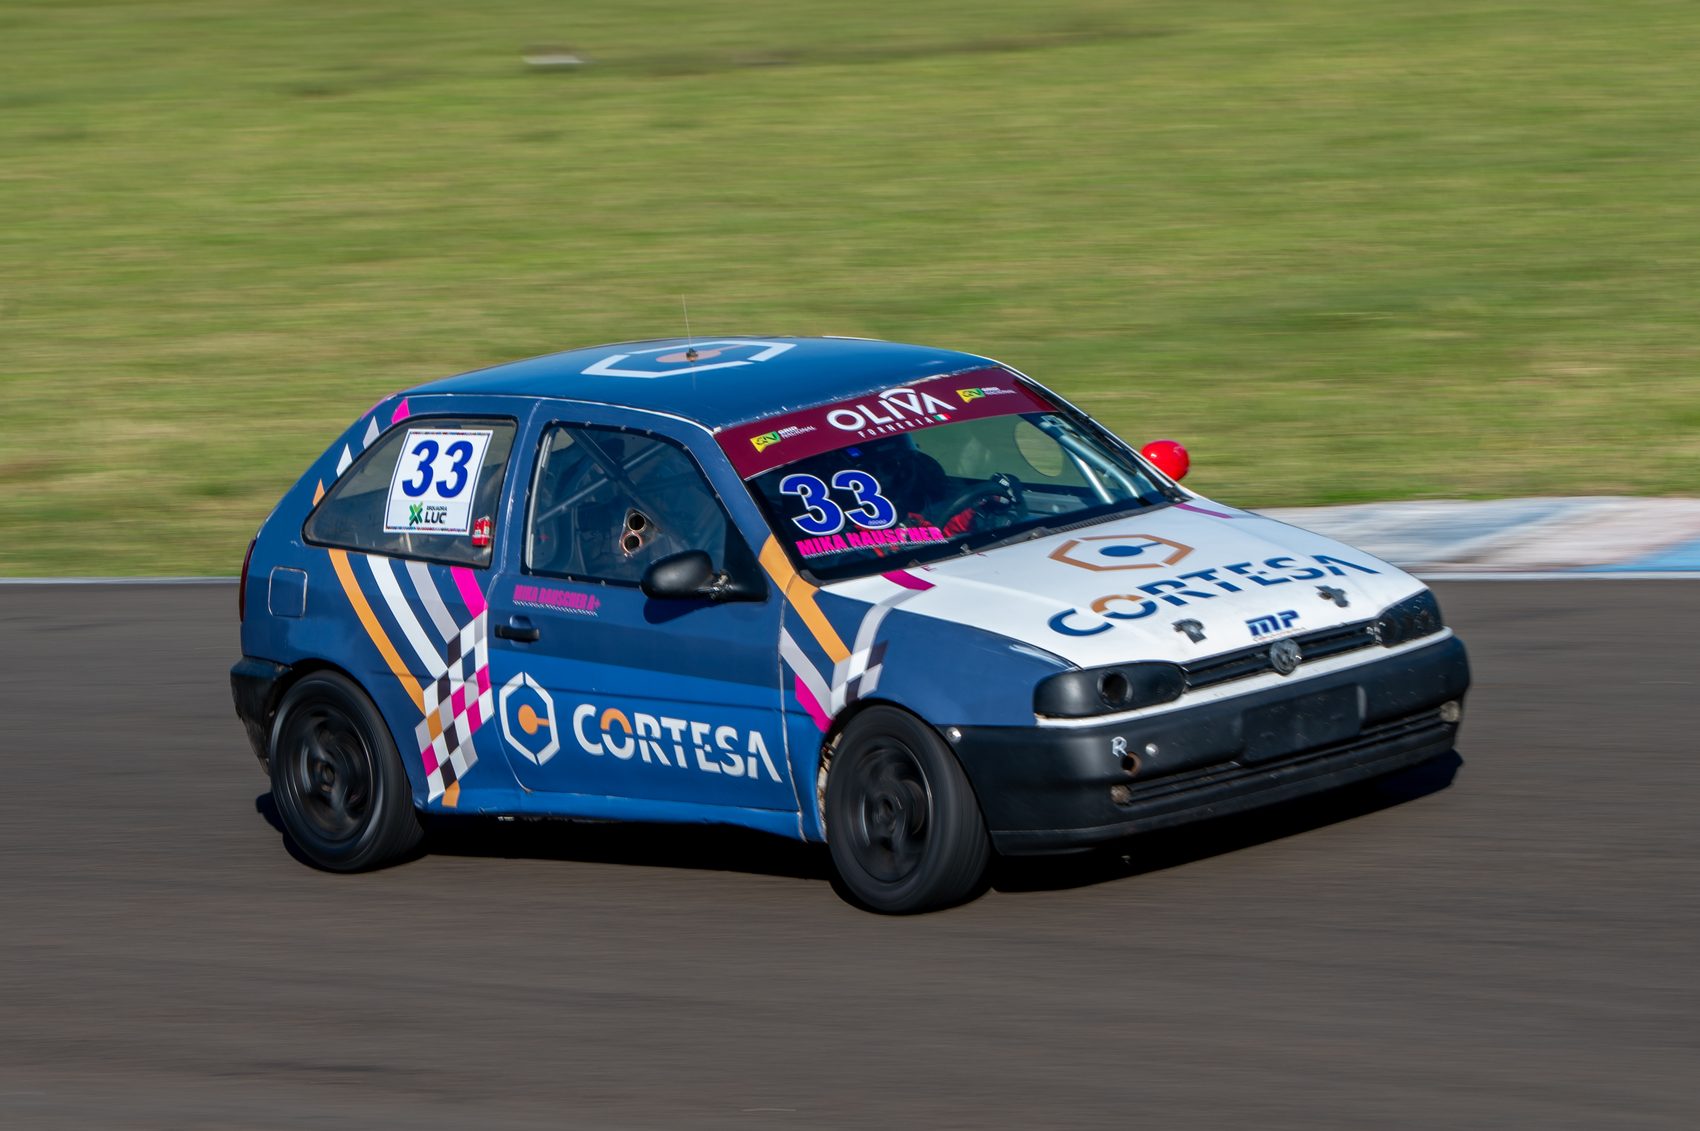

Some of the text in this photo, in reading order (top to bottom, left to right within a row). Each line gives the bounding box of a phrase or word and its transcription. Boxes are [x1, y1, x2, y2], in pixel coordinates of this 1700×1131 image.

[826, 388, 957, 431] OLIVA
[858, 415, 934, 439] FORNERIA
[402, 439, 474, 499] 33
[424, 511, 447, 524] LUC
[779, 469, 898, 536] 33
[795, 534, 849, 557] MIKA
[1047, 554, 1383, 637] CORTESA
[573, 704, 783, 783] CORTESA
[1111, 736, 1128, 758] R
